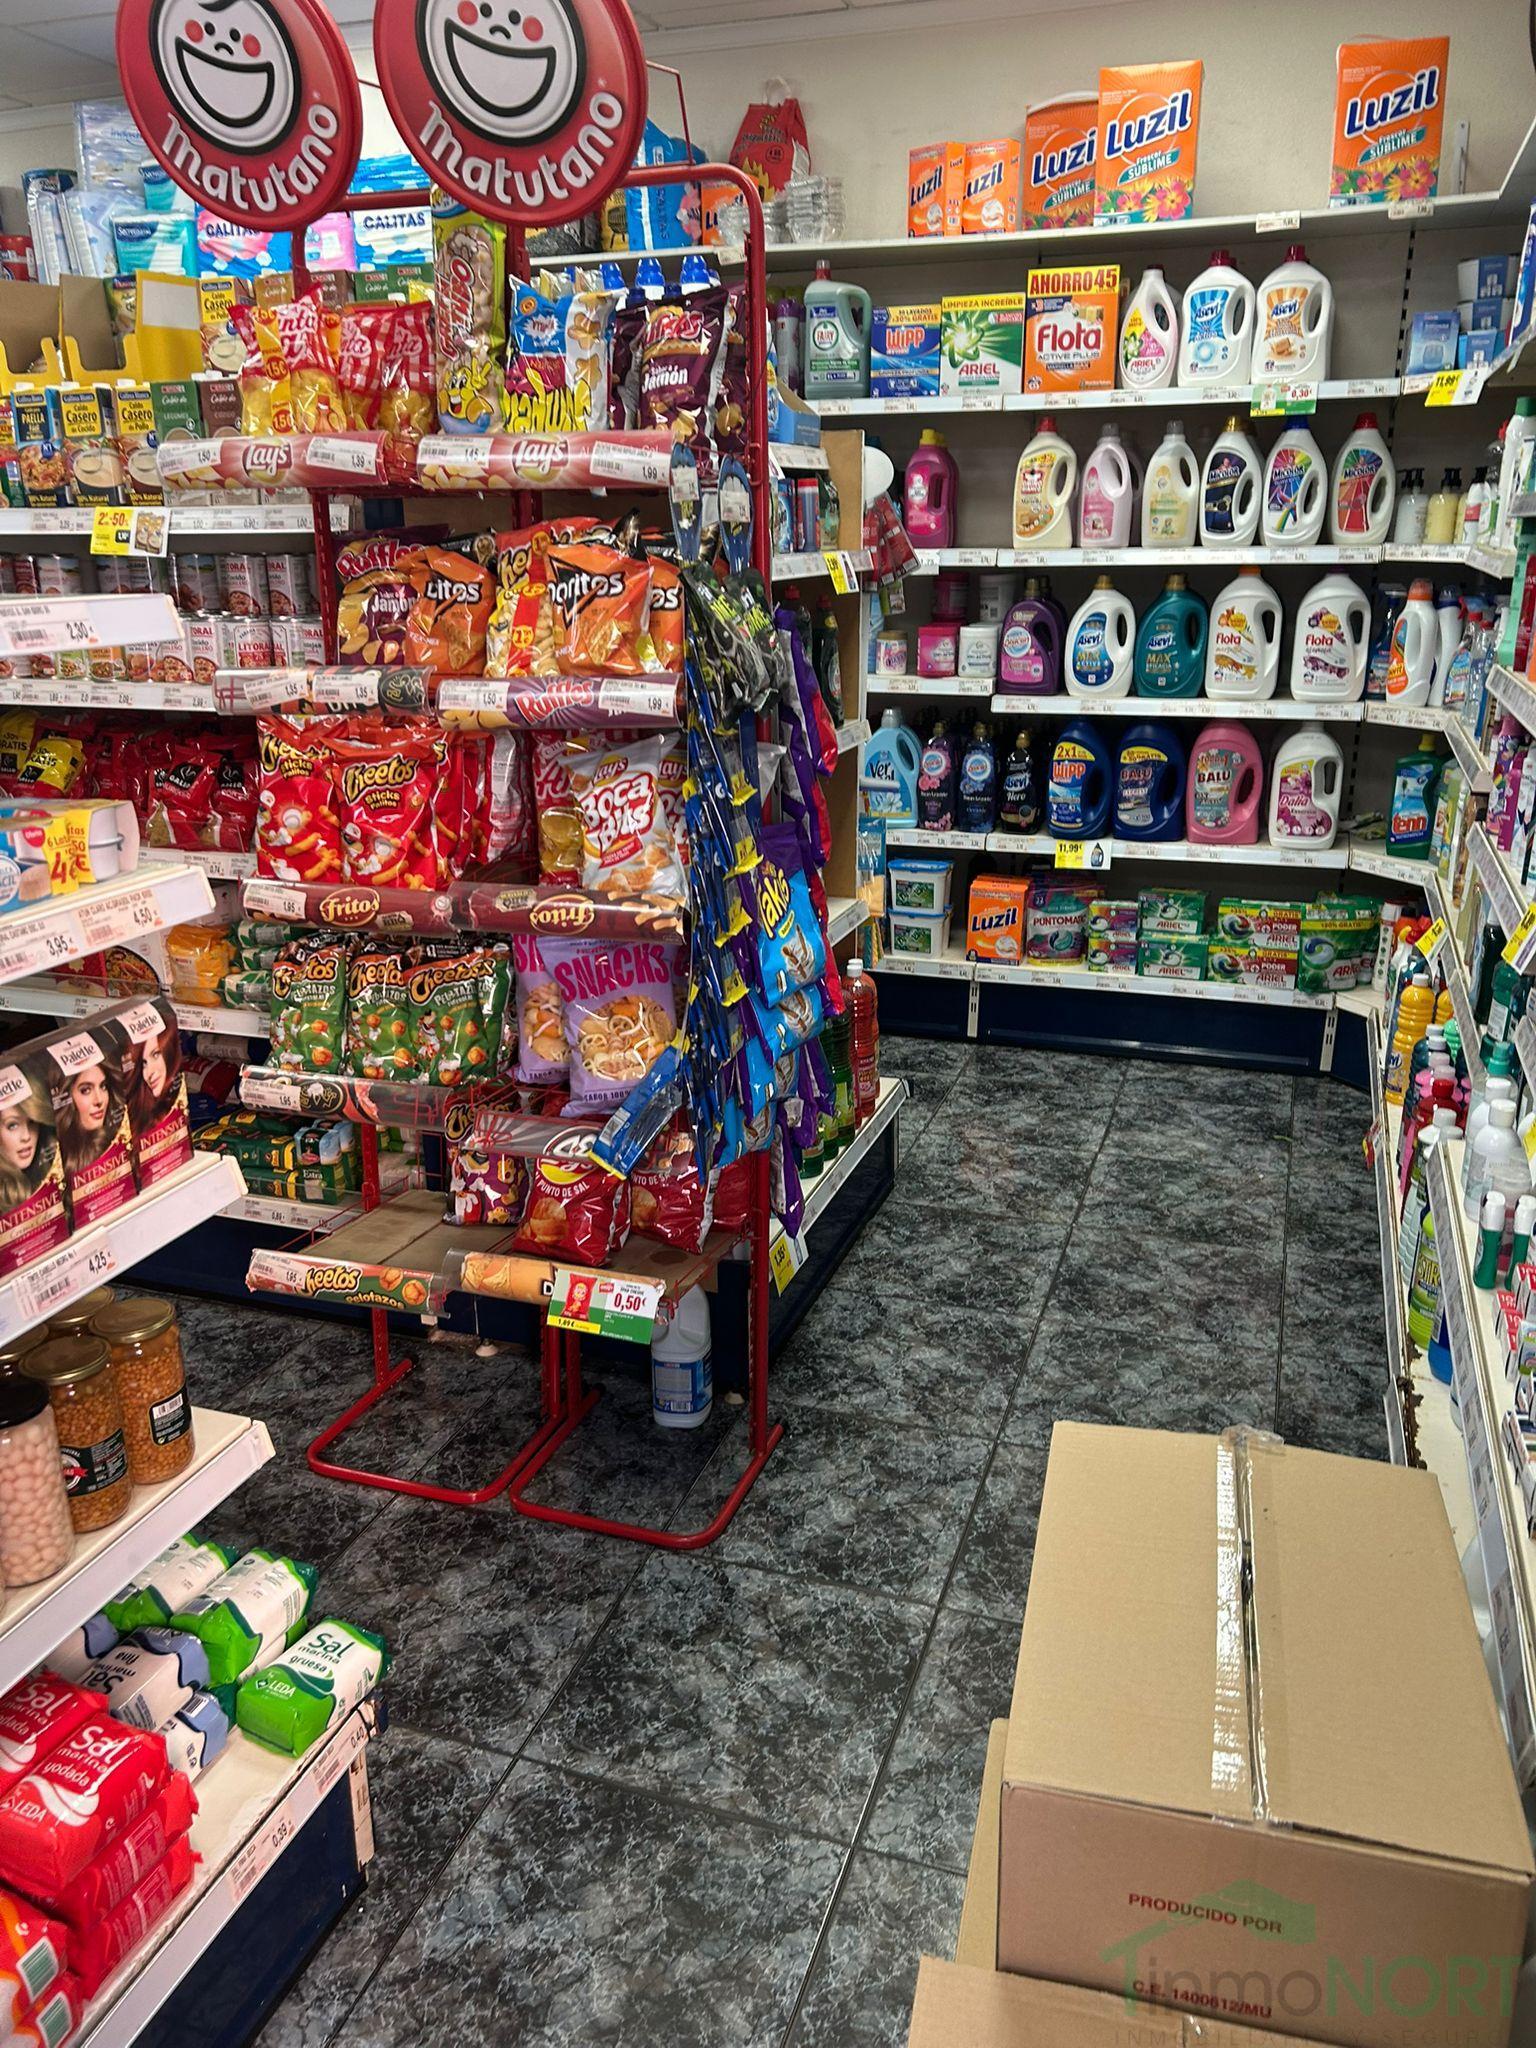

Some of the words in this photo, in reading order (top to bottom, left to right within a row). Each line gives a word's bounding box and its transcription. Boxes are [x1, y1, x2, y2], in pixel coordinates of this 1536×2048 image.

[1346, 67, 1439, 138] Luzil
[1106, 89, 1192, 158] Luzil
[162, 103, 338, 212] matutano
[418, 91, 624, 206] matutano
[1031, 129, 1097, 186] Luzi
[1370, 133, 1418, 159] SUBLIME
[1128, 157, 1173, 180] SUBLIME
[363, 212, 426, 231] CALITAS
[1031, 270, 1092, 295] AHORRO
[1094, 268, 1117, 290] 45
[943, 300, 979, 308] LIMPIEZA
[981, 297, 1023, 307] INCREÍBLE
[816, 330, 835, 342] FAIRY
[886, 327, 926, 350] WIPP
[1037, 322, 1102, 353] Flota
[959, 363, 1000, 376] ARIEL
[66, 411, 97, 424] Casero
[121, 408, 153, 420] Casero
[238, 642, 272, 651] LITORA
[1216, 633, 1241, 645] Flota
[1305, 633, 1334, 647] Flota
[516, 681, 596, 724] Ruffles
[343, 754, 419, 805] Cheetos
[1197, 770, 1232, 783] BALU
[133, 907, 153, 925] 4,50
[324, 893, 380, 921] Fritos
[971, 907, 1018, 932] Luzil
[46, 936, 69, 956] 3,95
[554, 944, 671, 1004] SNACKS
[129, 1013, 160, 1037] Palette
[60, 1044, 96, 1068] Palette
[139, 1117, 187, 1150] INTENSIVE
[73, 1150, 128, 1188] INTENSIVE
[0, 1191, 60, 1234] INTENSIVE
[89, 1250, 107, 1273] 4,25
[614, 1291, 647, 1312] 0,50€
[298, 1644, 341, 1666] marina
[308, 1632, 356, 1657] Sal
[288, 1654, 327, 1673] gruesa
[269, 1678, 297, 1698] LEDA
[15, 1680, 69, 1722] Sal
[70, 1724, 125, 1764] Sal
[57, 1745, 108, 1774] marina
[44, 1759, 91, 1787] yodada
[16, 1798, 48, 1823] LEDA
[1128, 1893, 1238, 1926] PRODUCIDO
[1241, 1915, 1284, 1934] POR
